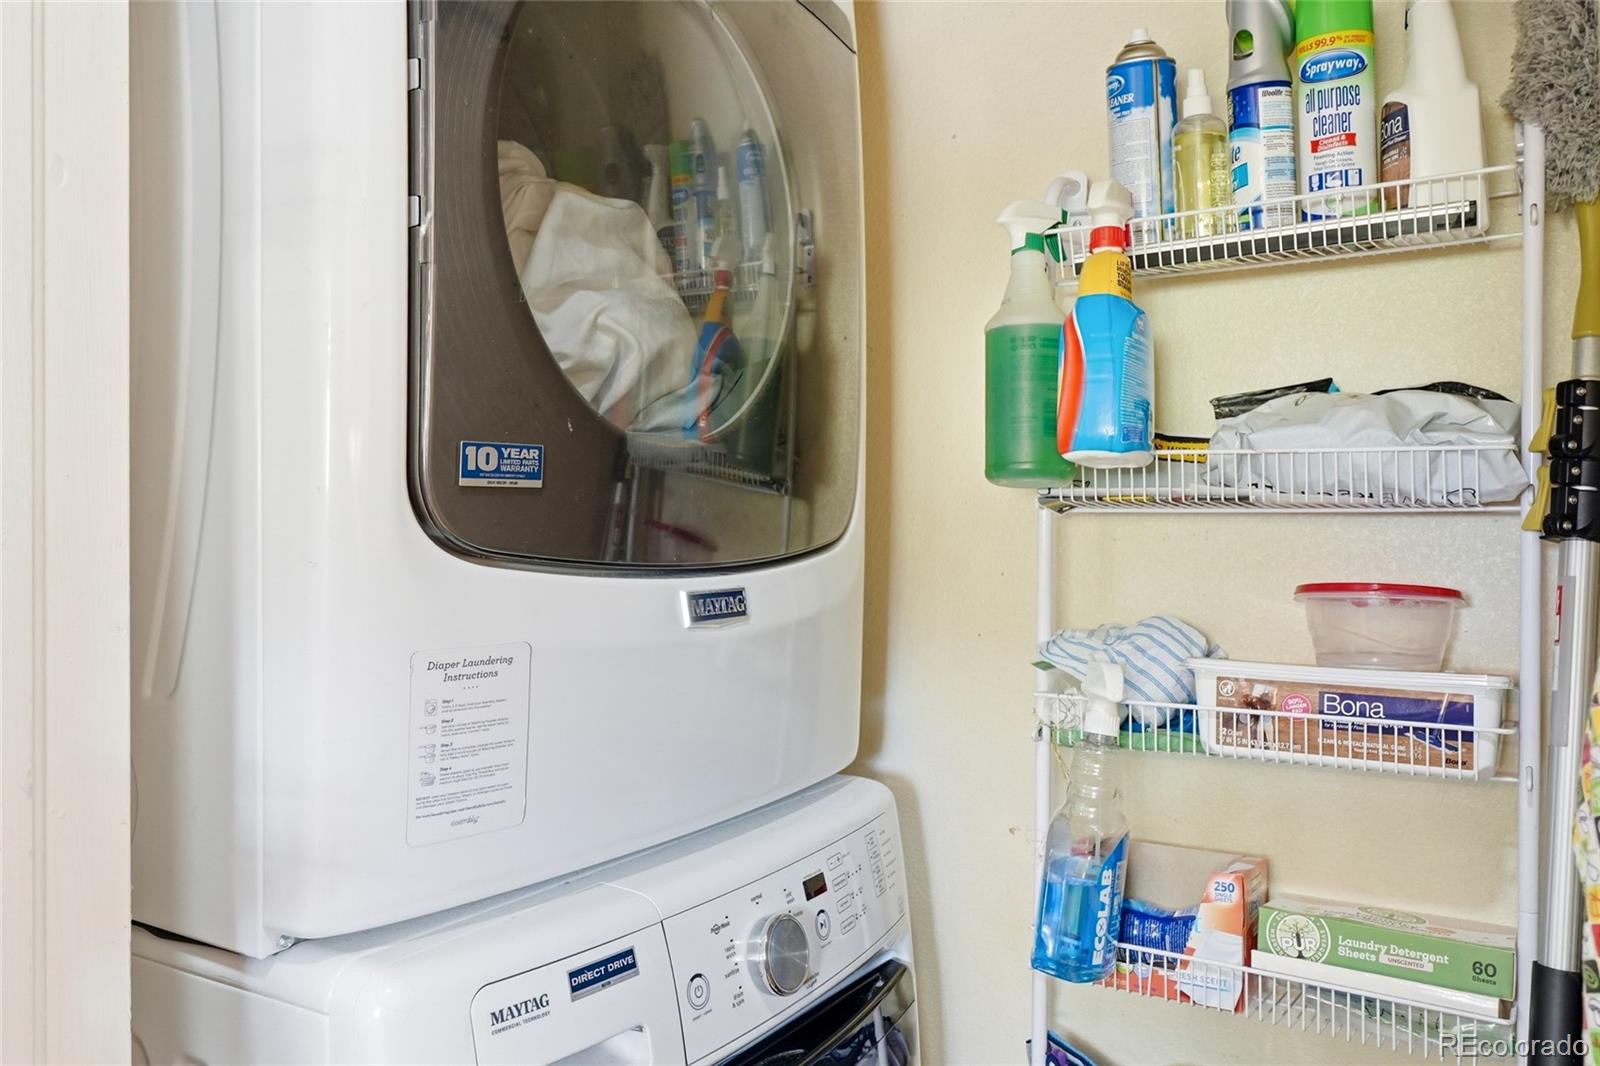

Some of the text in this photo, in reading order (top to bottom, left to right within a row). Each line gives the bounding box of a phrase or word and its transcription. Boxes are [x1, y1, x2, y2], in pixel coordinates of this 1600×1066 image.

[1305, 58, 1361, 79] Sprayway
[1109, 93, 1135, 108] EANER
[1305, 84, 1361, 114] all purpose
[1313, 111, 1353, 137] cleaner
[465, 446, 539, 472] 10 YEAR
[690, 596, 745, 618] MAYTAG
[427, 655, 514, 672] Diaper Laundering
[443, 670, 499, 682] Instructions
[1324, 694, 1386, 718] Bona
[1214, 881, 1235, 893] 250
[1091, 868, 1112, 965] ECOLAB
[1337, 946, 1425, 969] Sheets UNSCENTED
[1338, 935, 1449, 965] Laundry Detergent
[571, 966, 606, 987] DIRECT
[607, 955, 634, 972] DRIVE
[1471, 961, 1498, 978] 60
[1471, 975, 1497, 986] Sheets
[490, 993, 550, 1027] MAYTAG
[491, 1010, 551, 1036] COMMERCIAL TECHNOLOGY
